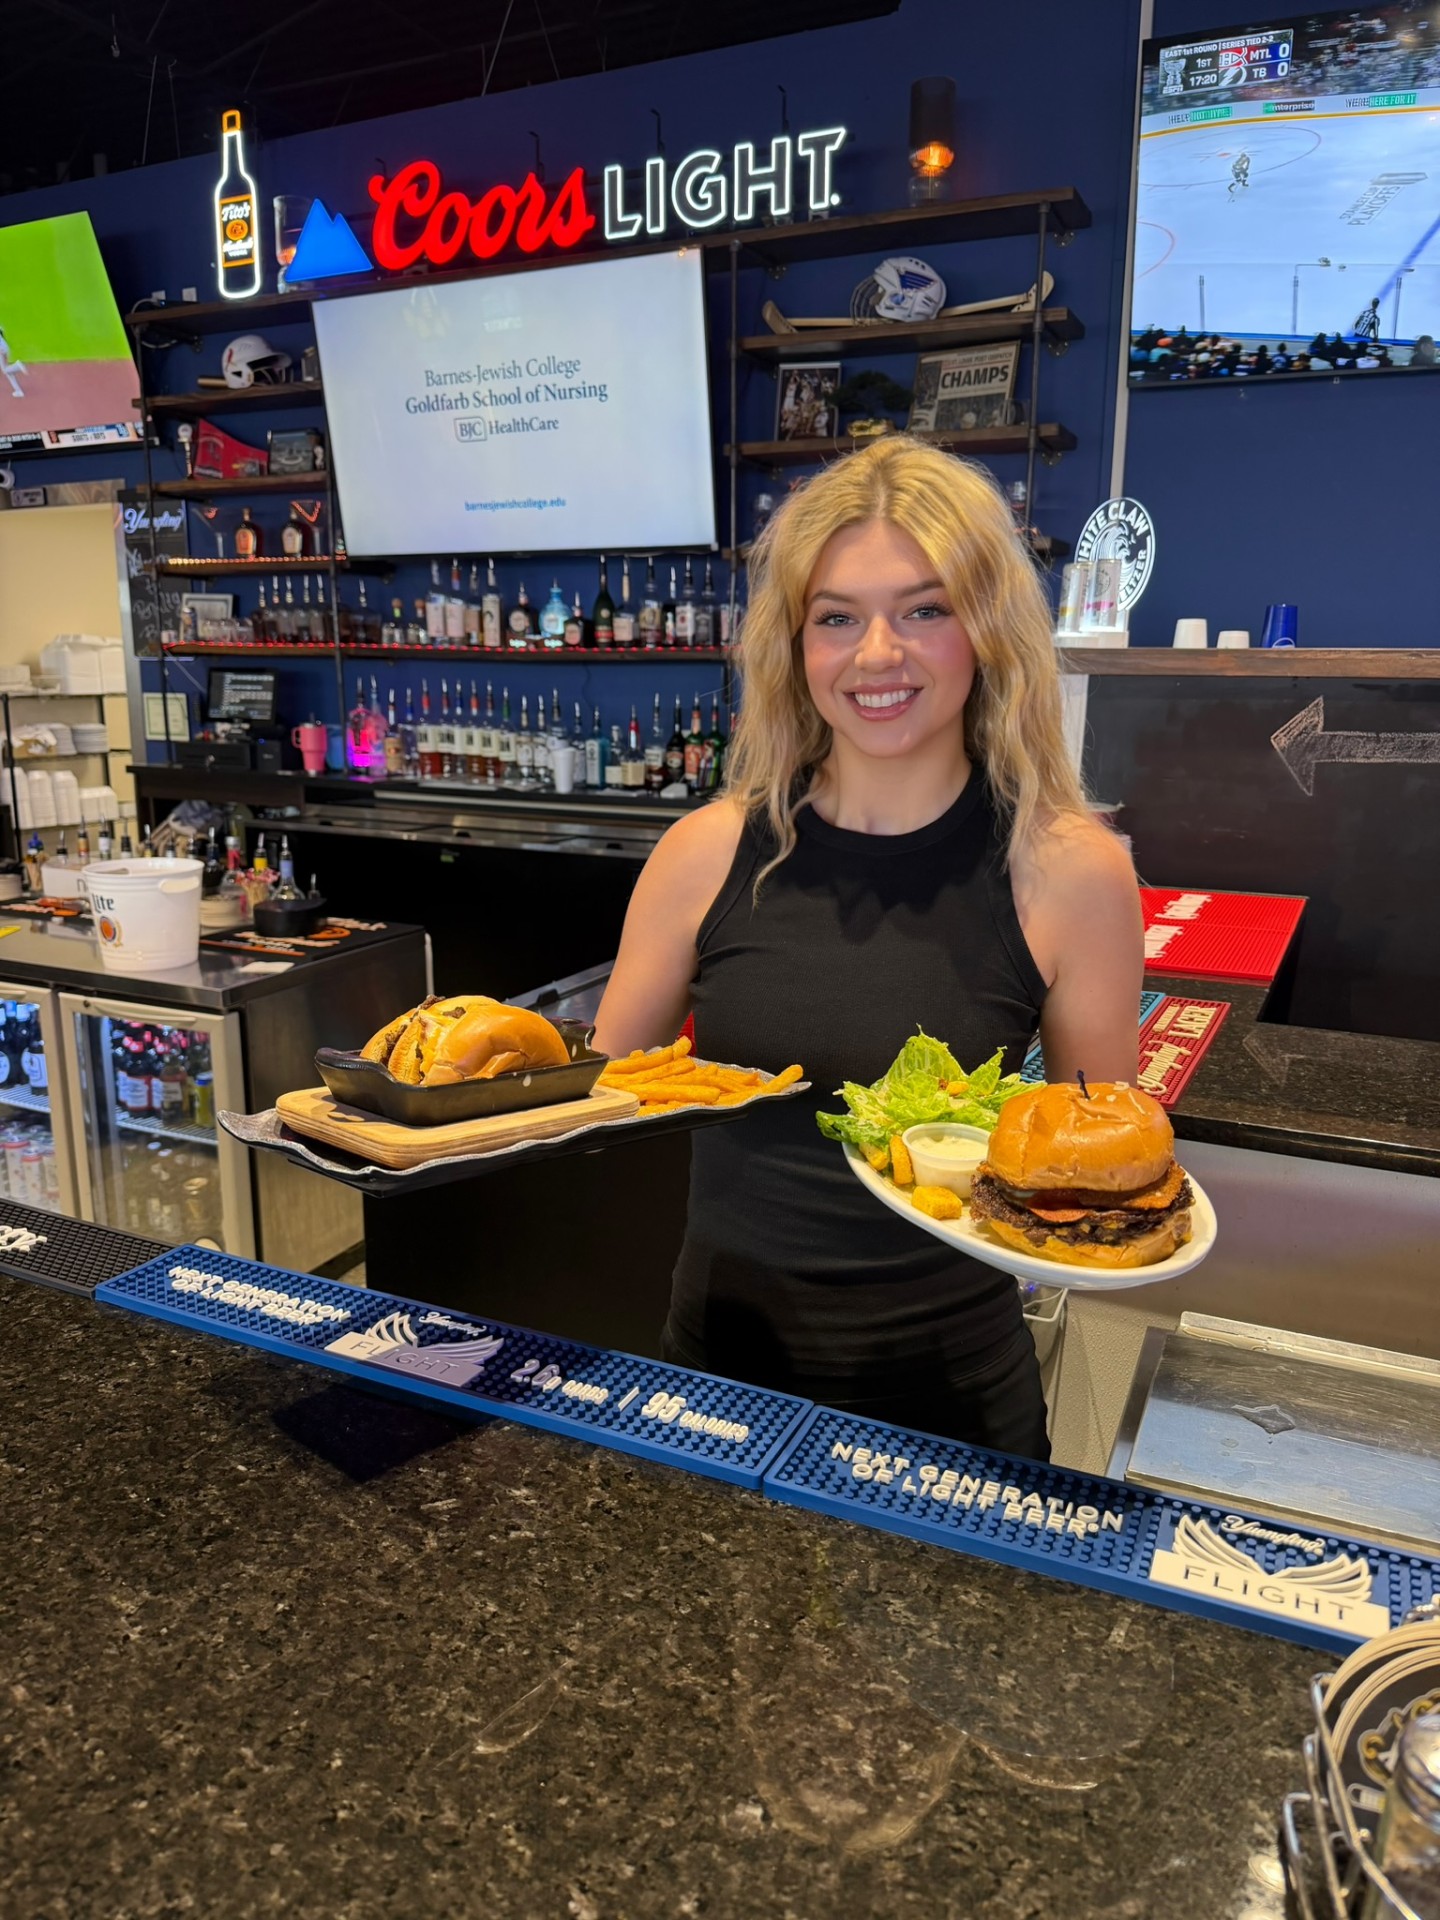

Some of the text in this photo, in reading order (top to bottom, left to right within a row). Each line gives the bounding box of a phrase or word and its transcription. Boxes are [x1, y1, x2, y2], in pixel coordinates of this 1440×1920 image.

[1164, 35, 1274, 58] EAST 1st ROUND SERIES TIED 2-2
[1196, 58, 1212, 68] 1ST
[1250, 50, 1272, 61] MTL
[1279, 43, 1290, 58] 0
[1189, 74, 1217, 87] 17:20
[1252, 67, 1267, 79] TB
[1277, 61, 1288, 77] 0
[1162, 84, 1183, 95] ESPN
[1369, 95, 1389, 107] HERE
[1390, 94, 1406, 105] FOR
[222, 202, 251, 222] Tito's
[368, 159, 595, 270] Coors
[424, 355, 581, 388] Barnes-Jewish College
[940, 364, 1009, 390] CHAMPS
[405, 381, 609, 414] Goldfarb School of Nursing
[458, 416, 560, 440] BJC HealthCare
[1078, 501, 1149, 561] HITE CLAW
[1168, 1005, 1217, 1040] LAGER
[168, 1265, 351, 1323] NEXT GENERATION
[171, 1278, 204, 1294] OF
[200, 1286, 263, 1312] LIGHT
[349, 1340, 461, 1375] FLIGHT
[561, 1379, 609, 1405] CARBS
[641, 1391, 687, 1424] 95
[678, 1410, 749, 1444] CALORIES
[831, 1441, 1123, 1533] NEXT GENERATION
[852, 1463, 893, 1484] OF
[902, 1475, 994, 1512] LIGHT
[1221, 1515, 1326, 1556] Yuengling
[1184, 1564, 1353, 1620] FLIGHT
